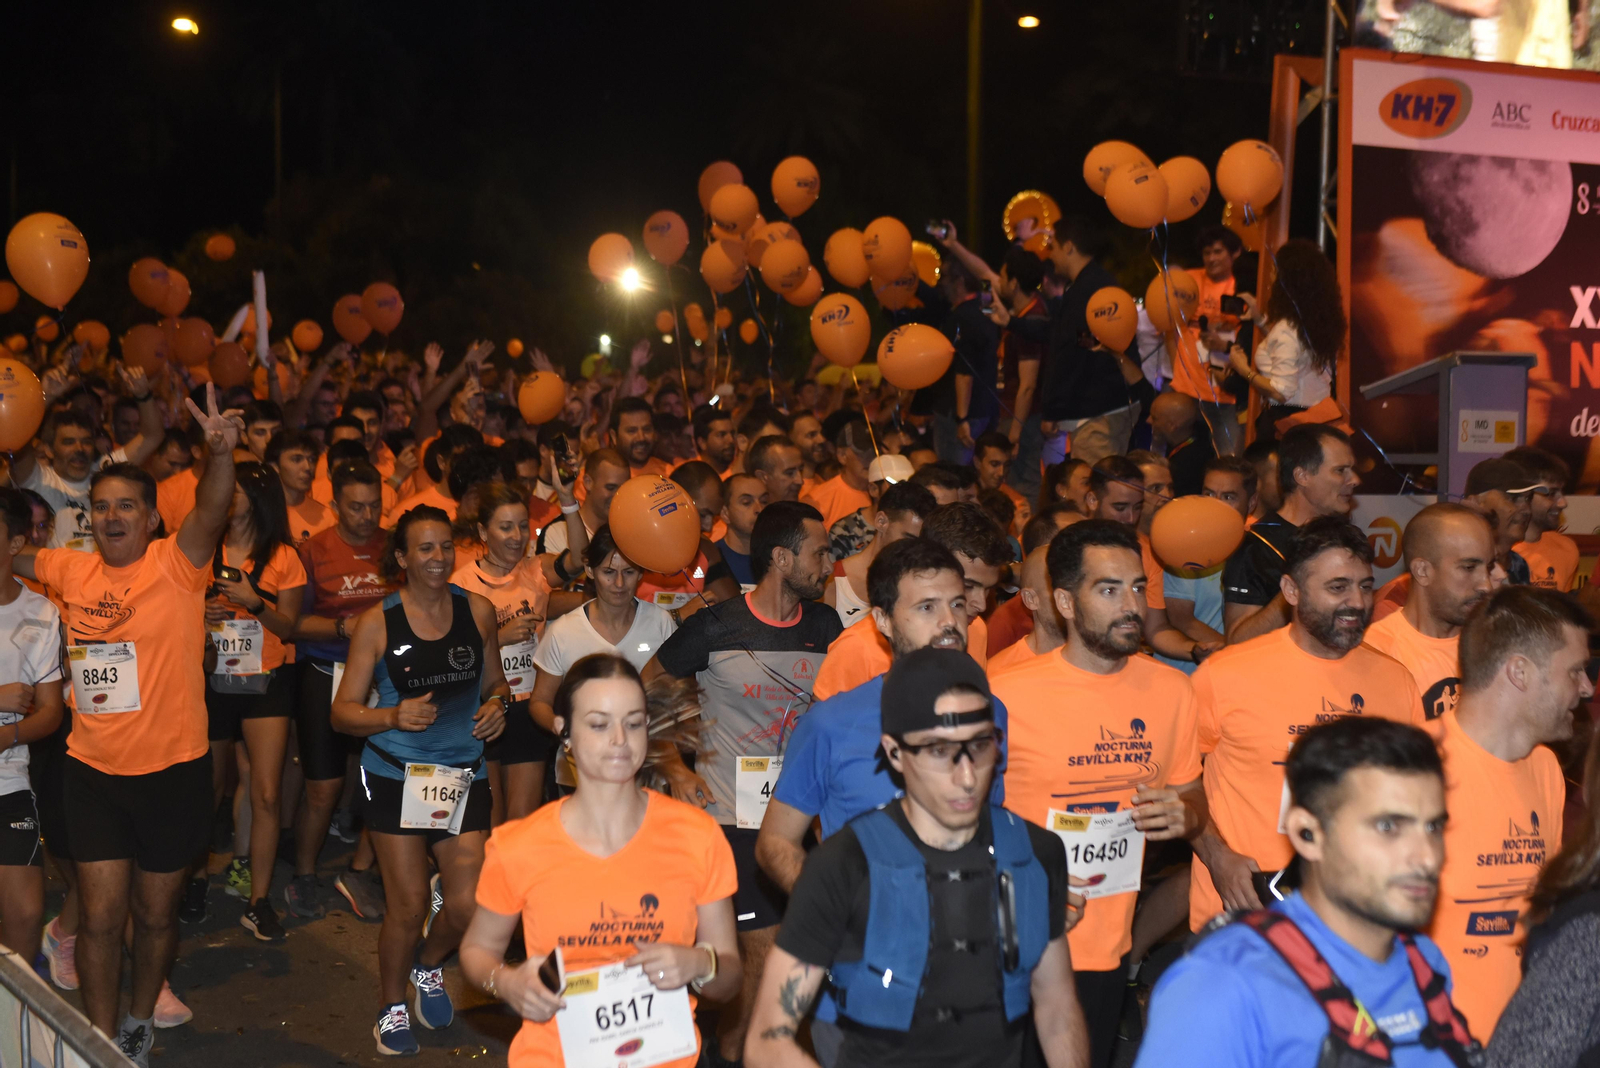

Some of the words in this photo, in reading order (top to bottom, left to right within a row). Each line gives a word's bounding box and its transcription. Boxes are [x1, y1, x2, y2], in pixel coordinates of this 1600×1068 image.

[1492, 102, 1532, 123] ABC
[1474, 420, 1489, 430] IMD
[83, 667, 118, 686] 8843
[422, 673, 446, 687] LAURUS
[447, 670, 476, 683] TRIATLON
[743, 683, 761, 698] XI
[1095, 741, 1153, 752] NOCTURNA
[1068, 752, 1121, 766] SEVILLA
[1071, 838, 1128, 864] 16450
[1502, 838, 1545, 850] NOCTURNA
[1476, 852, 1523, 867] SEVILLA
[590, 921, 664, 932] NOCTURNA
[558, 935, 621, 947] SEVILLA
[595, 993, 654, 1031] 6517
